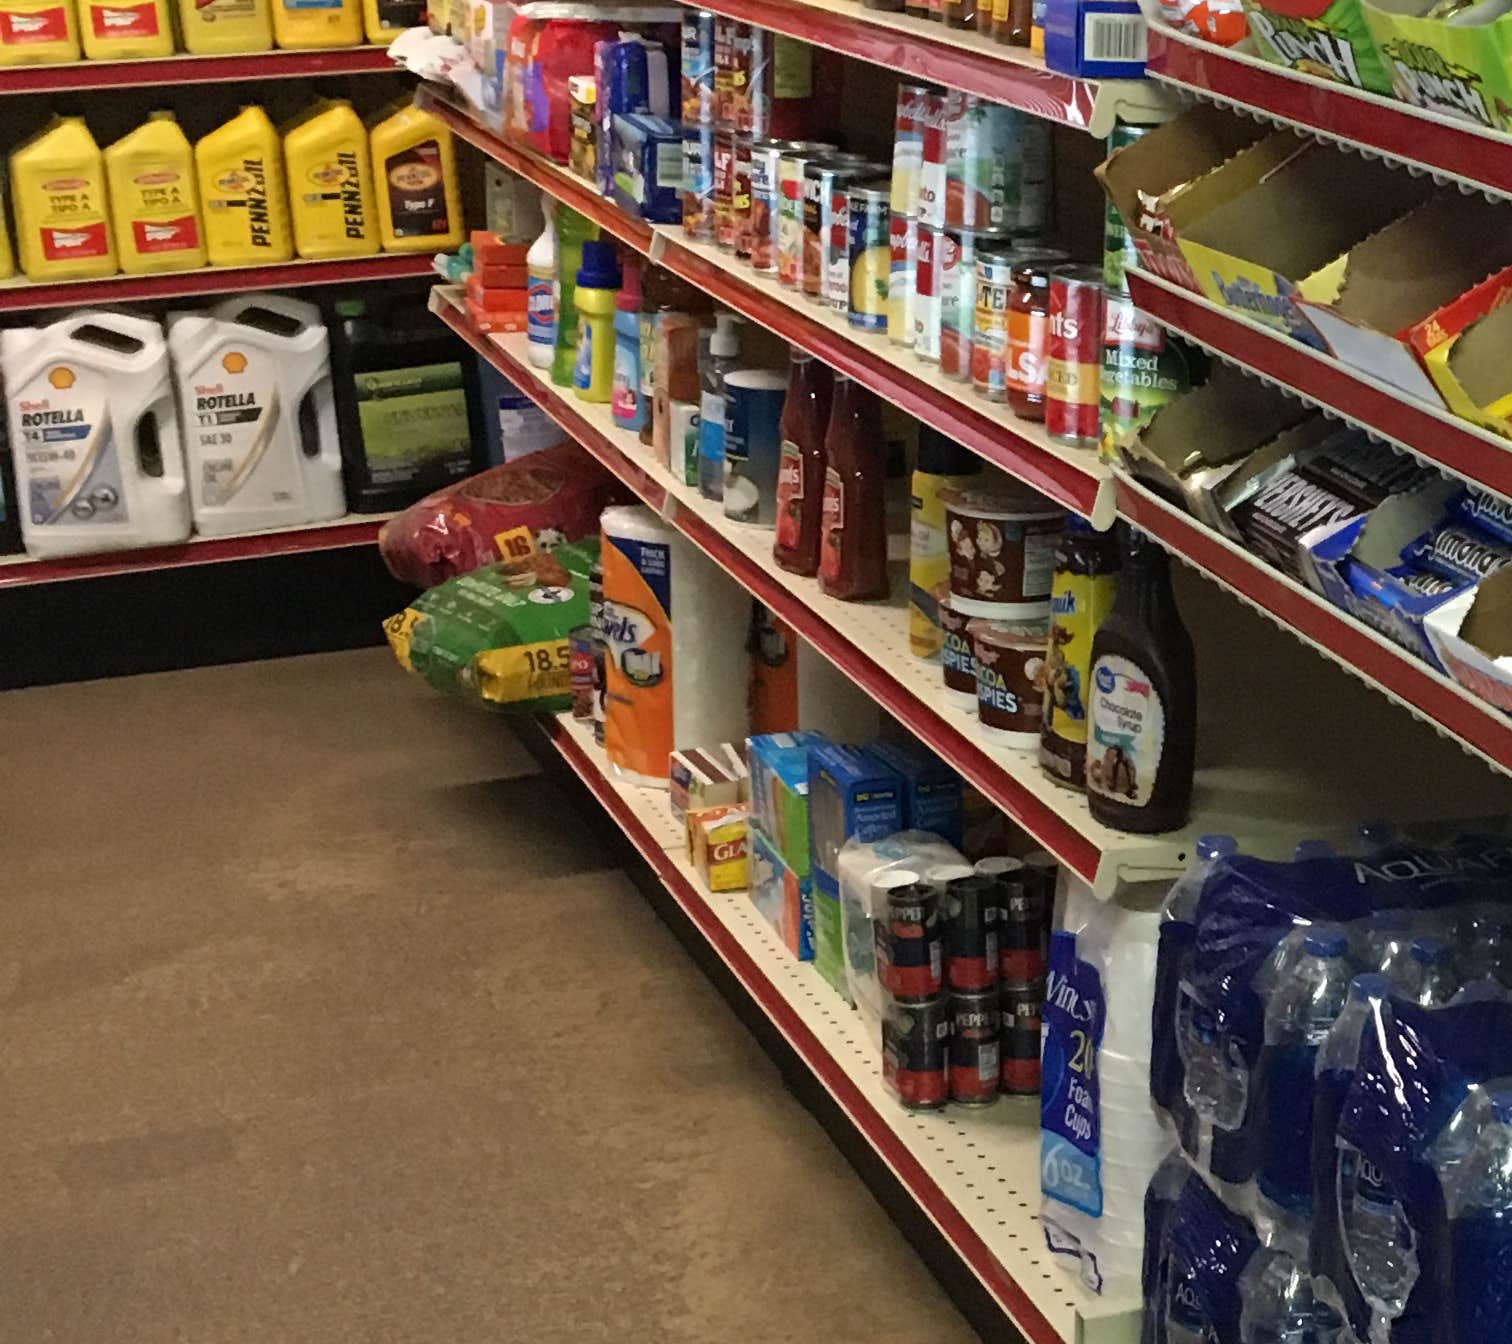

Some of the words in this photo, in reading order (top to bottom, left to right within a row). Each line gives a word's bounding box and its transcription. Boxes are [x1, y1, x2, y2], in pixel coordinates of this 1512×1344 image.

[1251, 11, 1362, 88] PUNCH
[47, 194, 77, 206] TYPE
[81, 193, 91, 205] A
[139, 188, 167, 200] TYPE
[170, 187, 179, 199] A
[142, 196, 169, 206] TIPO
[171, 195, 181, 206] A
[49, 203, 78, 213] TIPO
[82, 201, 91, 212] A
[1105, 348, 1158, 372] Mixed
[195, 384, 223, 395] Shell
[20, 400, 49, 412] Shell
[196, 392, 255, 411] ROTELLA
[22, 409, 84, 427] ROTELLA
[504, 536, 531, 556] 16
[1101, 698, 1142, 722] Chocolate
[1118, 716, 1142, 733] Syrup
[713, 840, 748, 863] GLA
[1068, 1077, 1094, 1113] Foa
[1065, 1106, 1091, 1140] Cups
